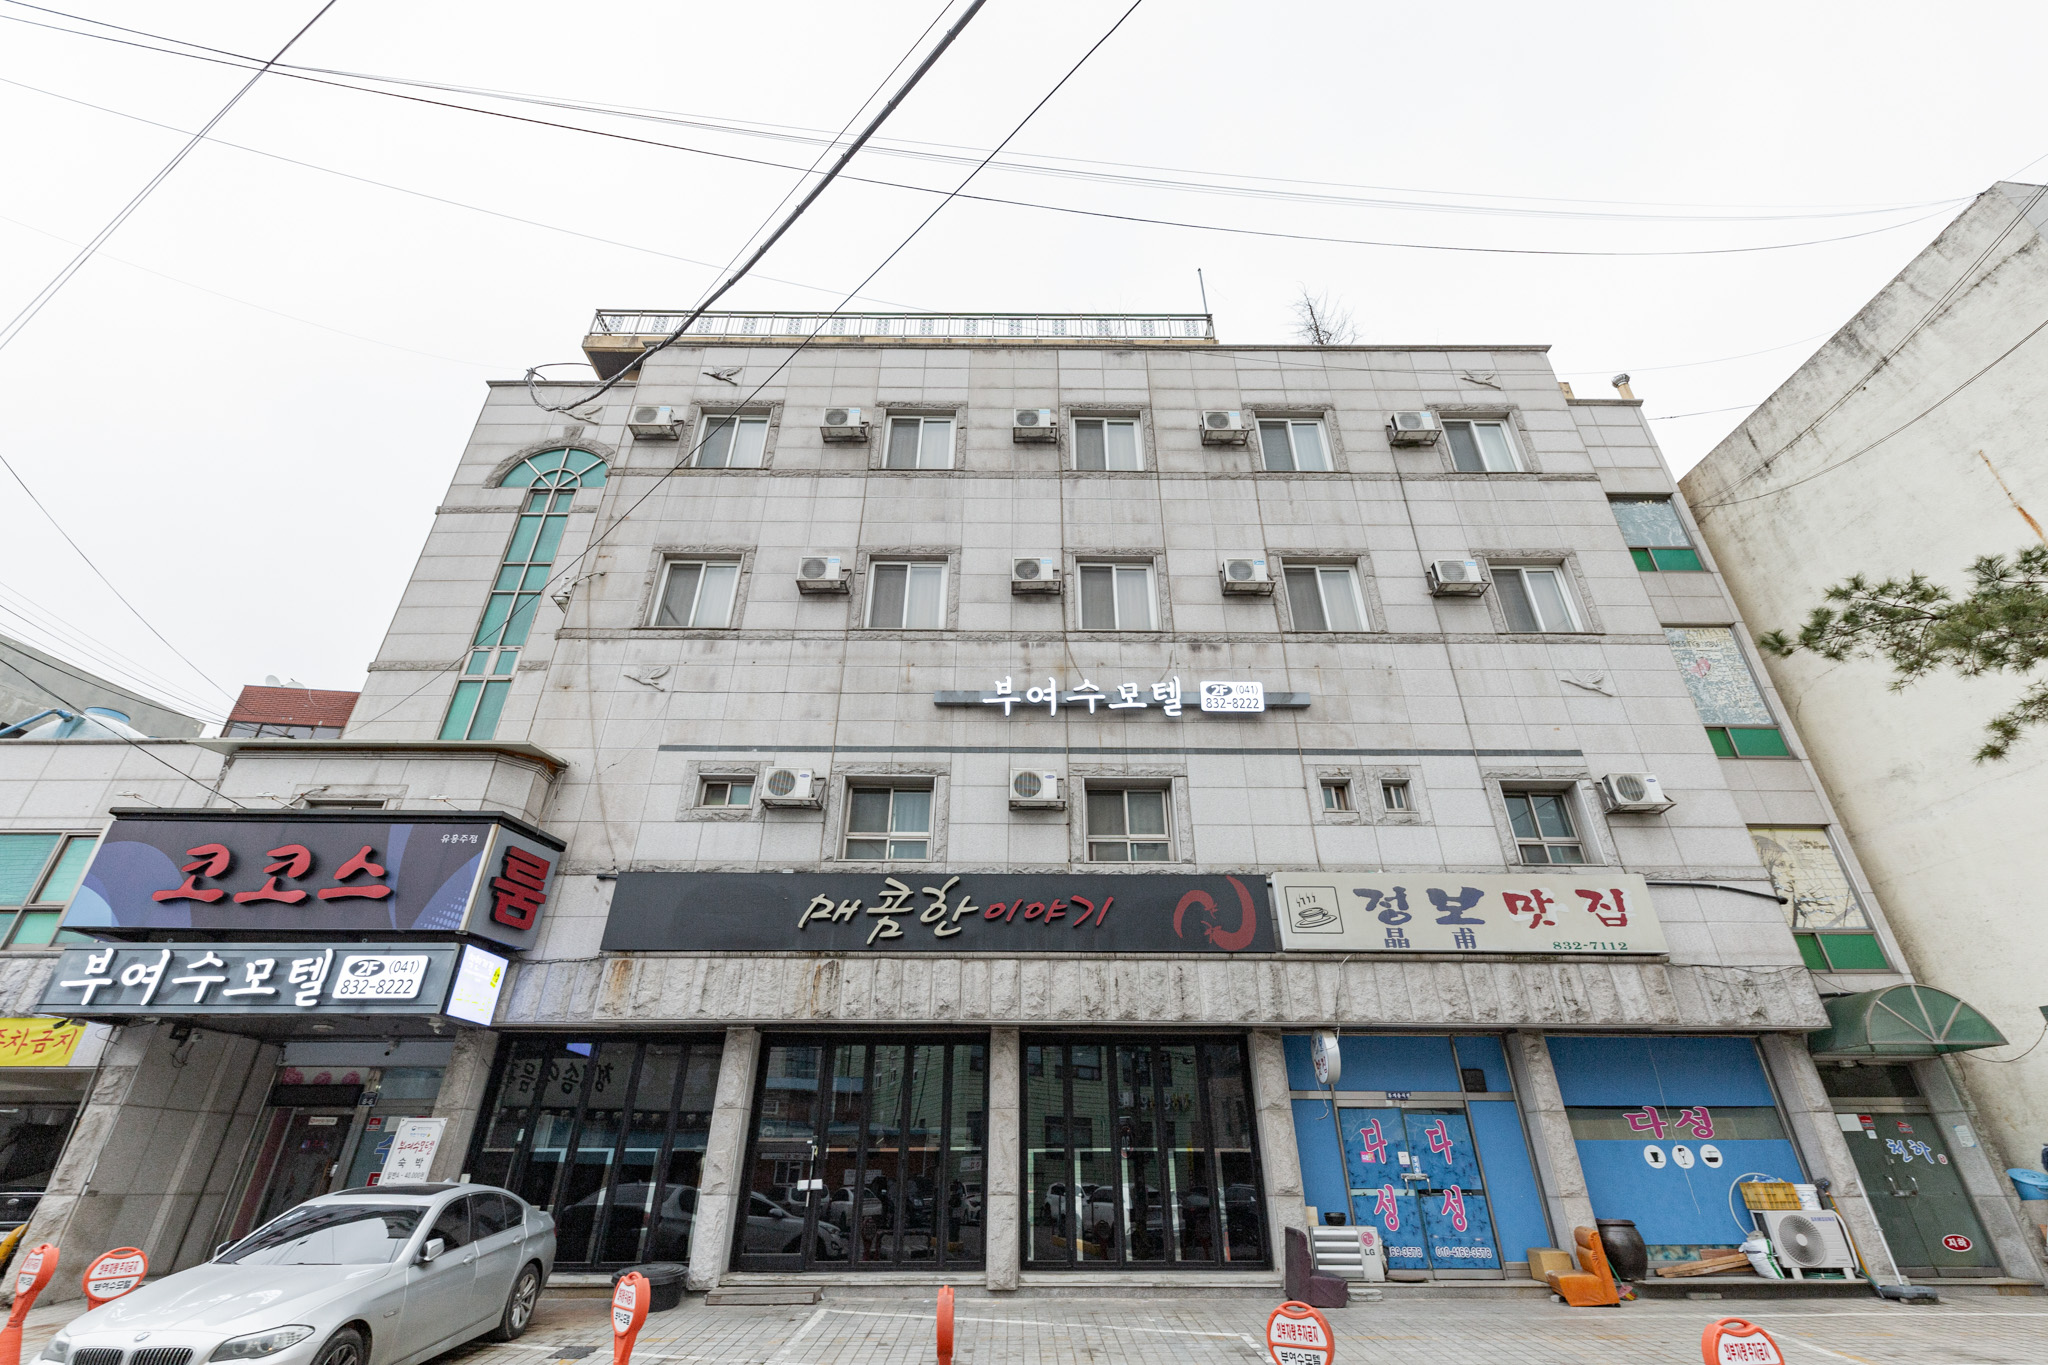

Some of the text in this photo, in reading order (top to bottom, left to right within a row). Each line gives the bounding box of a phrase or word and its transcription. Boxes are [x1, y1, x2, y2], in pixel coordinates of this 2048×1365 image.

[982, 675, 1182, 717] 부여수모텔
[1210, 684, 1258, 696] 2F (041)
[1206, 698, 1260, 708] 832-8222
[440, 833, 479, 844] 유흥주점
[151, 843, 392, 904] 코코스
[494, 846, 550, 930] 룸
[798, 876, 1114, 945] 매콤한 이야기
[1502, 889, 1629, 929] 맛집
[1552, 941, 1628, 950] 832-7112
[353, 960, 420, 977] 2F (041)
[60, 947, 335, 1008] 부여수모텔
[340, 979, 414, 995] 832-8222
[1622, 1106, 1716, 1140] 다성
[397, 1140, 436, 1155] 부여수모텔
[1947, 1236, 1968, 1248] 지하
[1364, 1248, 1376, 1256] LG
[1435, 1246, 1493, 1259] 010-4169-3578
